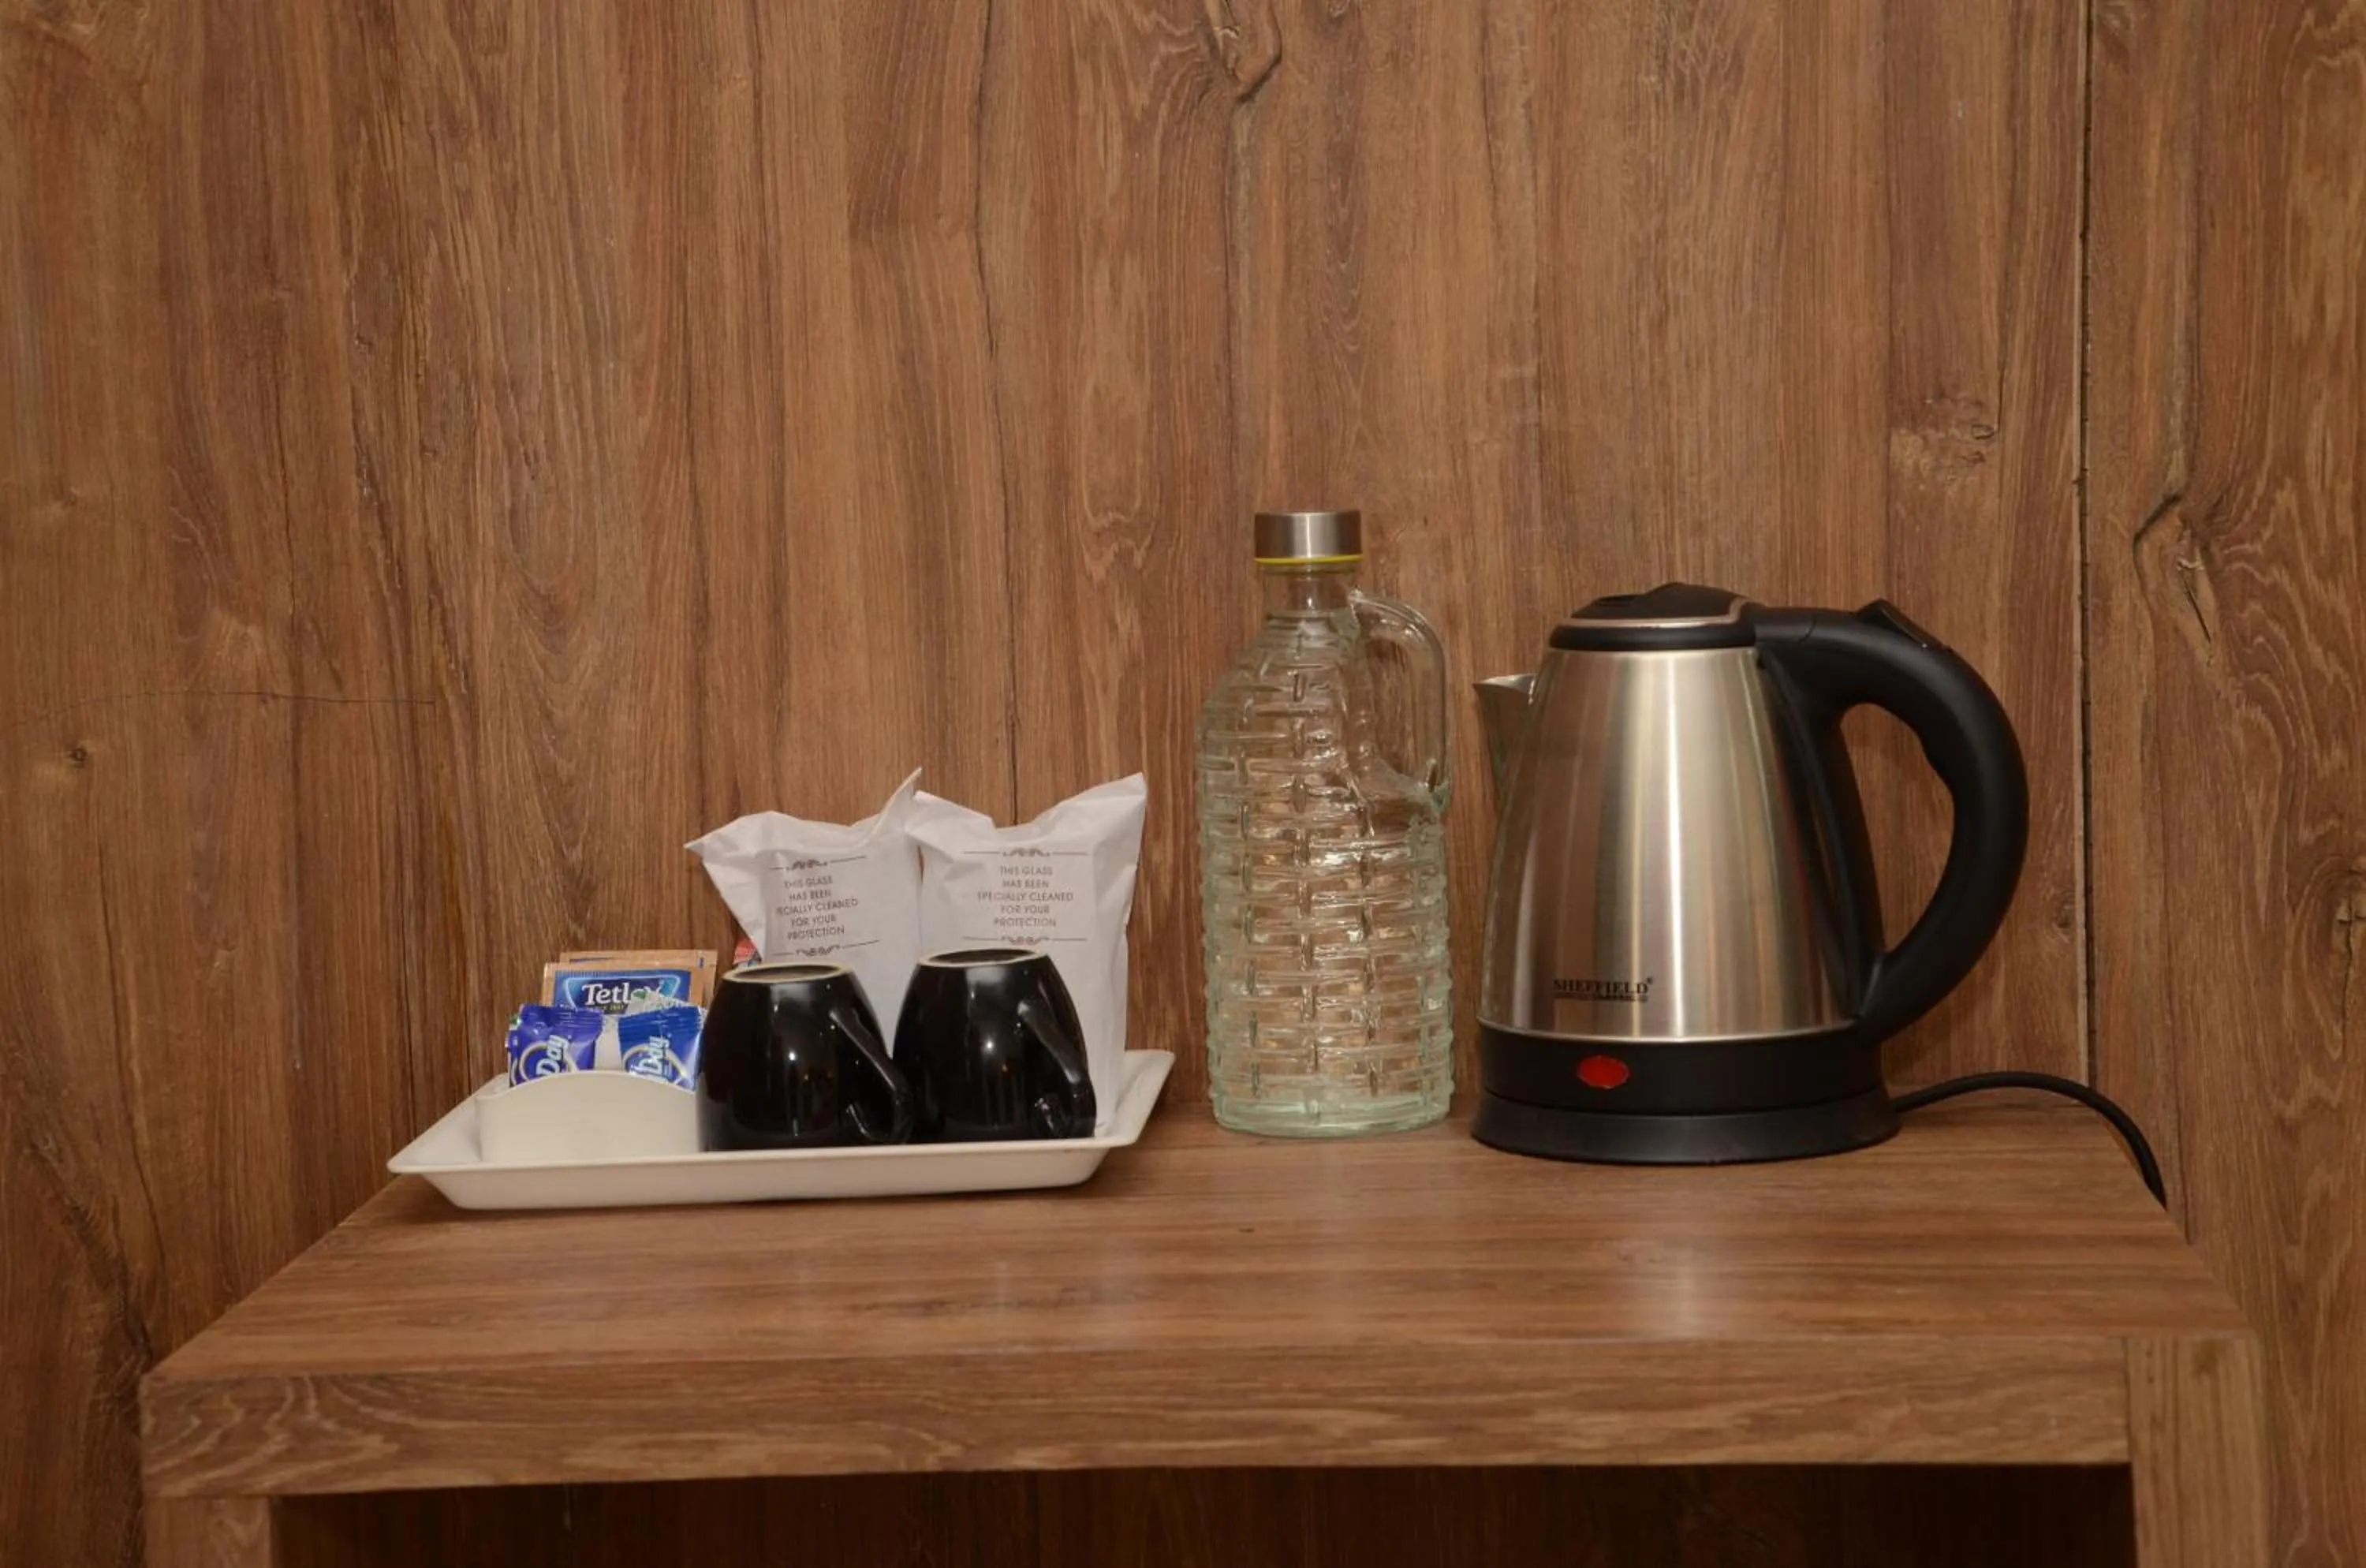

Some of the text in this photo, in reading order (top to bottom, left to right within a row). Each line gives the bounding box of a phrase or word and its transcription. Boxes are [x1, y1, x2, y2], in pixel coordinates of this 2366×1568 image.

[1000, 866, 1053, 875] THIS GLASS
[805, 875, 833, 887] GLASS
[1002, 879, 1049, 888] HAS BEEN
[789, 889, 831, 900] HAS BEEN
[977, 891, 1073, 902] SPECIALLY CLEANED
[815, 898, 859, 911] CLEANED
[1001, 905, 1050, 913] FOR YOUR
[791, 913, 837, 928] FOR YOUR
[994, 917, 1056, 927] PROTECTION
[787, 924, 845, 940] PROTECTION
[1554, 979, 1649, 994] SHEFFIELD
[582, 982, 662, 1006] Tetl
[536, 1035, 569, 1076] Day
[638, 1036, 670, 1074] Day
